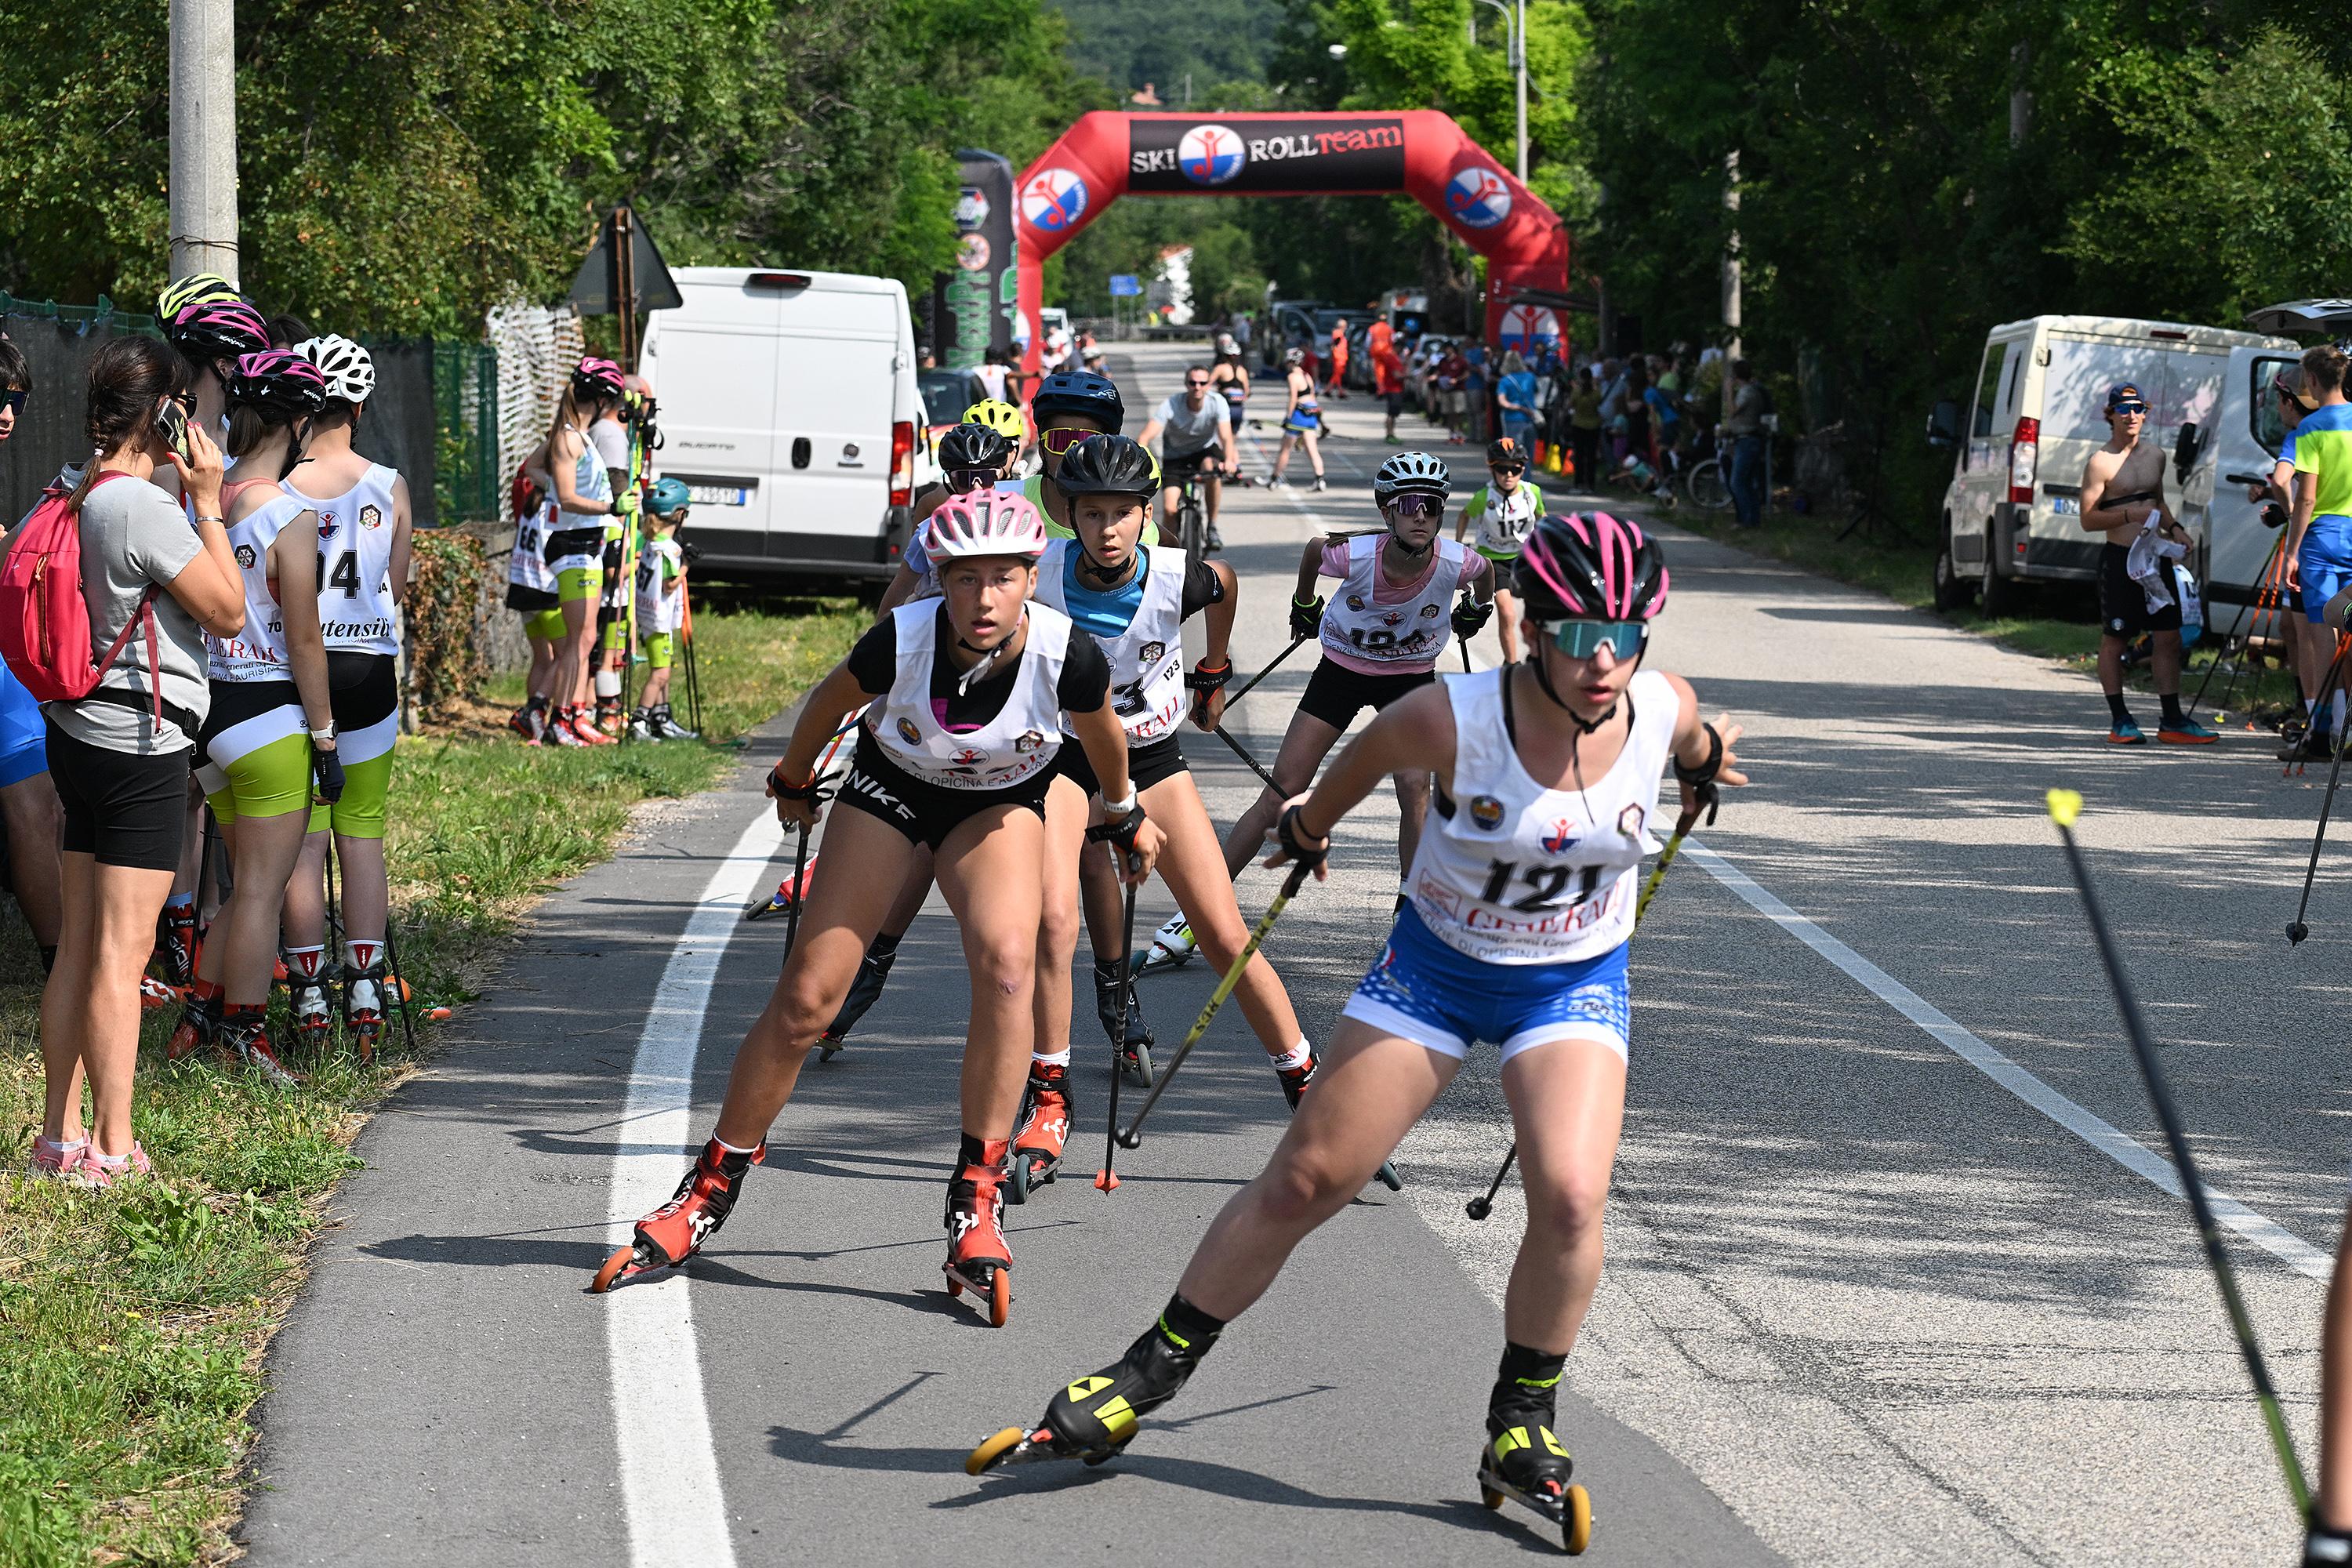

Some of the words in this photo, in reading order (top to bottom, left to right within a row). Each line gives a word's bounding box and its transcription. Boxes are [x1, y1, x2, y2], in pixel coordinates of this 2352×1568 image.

[1131, 148, 1176, 173] SKI
[1498, 517, 1528, 538] 117
[267, 621, 282, 633] 70
[1163, 659, 1181, 681] 123
[931, 776, 984, 788] OPICINA
[847, 769, 916, 820] NIKE
[1483, 859, 1604, 915] 121
